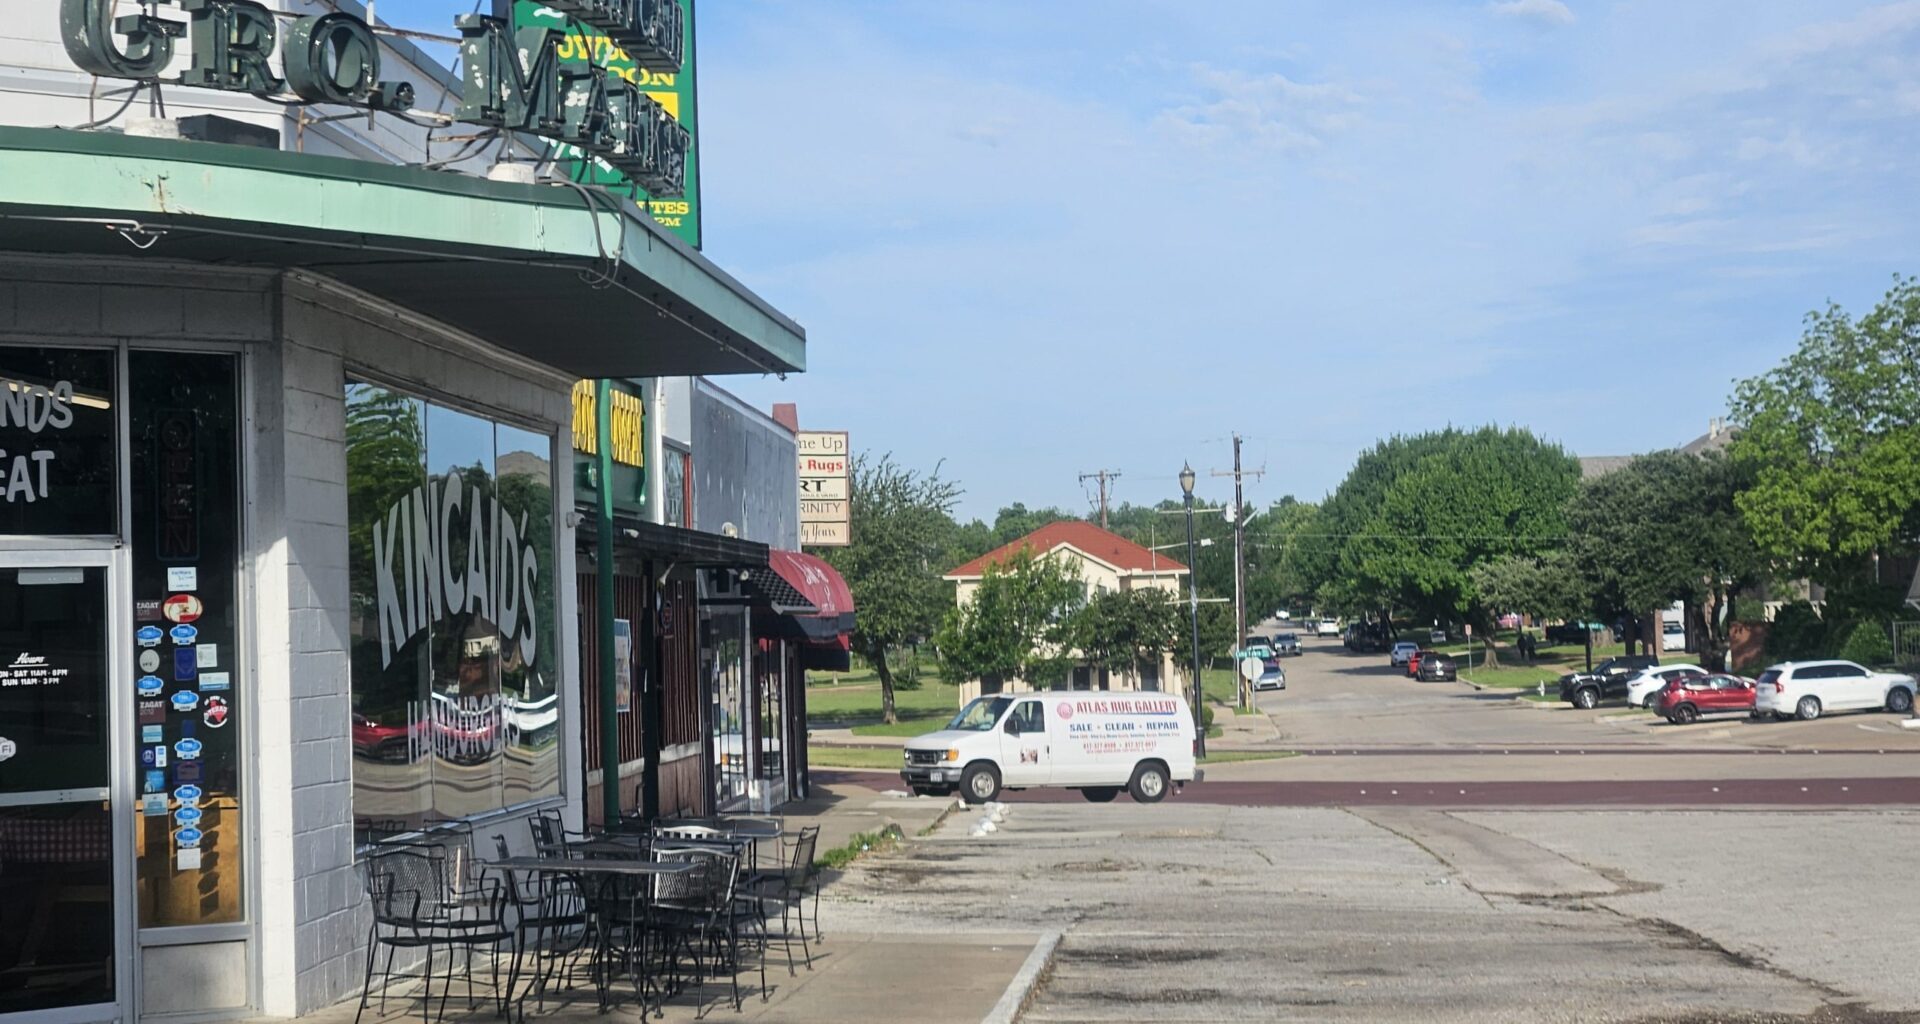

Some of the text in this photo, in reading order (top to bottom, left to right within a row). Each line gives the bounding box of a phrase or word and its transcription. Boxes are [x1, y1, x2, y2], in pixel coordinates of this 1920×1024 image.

[60, 0, 417, 110] GRO.
[0, 381, 74, 433] NDS
[822, 436, 843, 453] Up
[808, 459, 843, 473] Rugs
[13, 670, 28, 678] SAT
[2, 678, 18, 686] SUN
[139, 700, 164, 709] ZAGAT
[1076, 700, 1178, 714] ATLAS RUG GALLERY
[407, 691, 520, 765] HAMBURGERS
[1070, 721, 1179, 732] SALE CLEAN REPAIR
